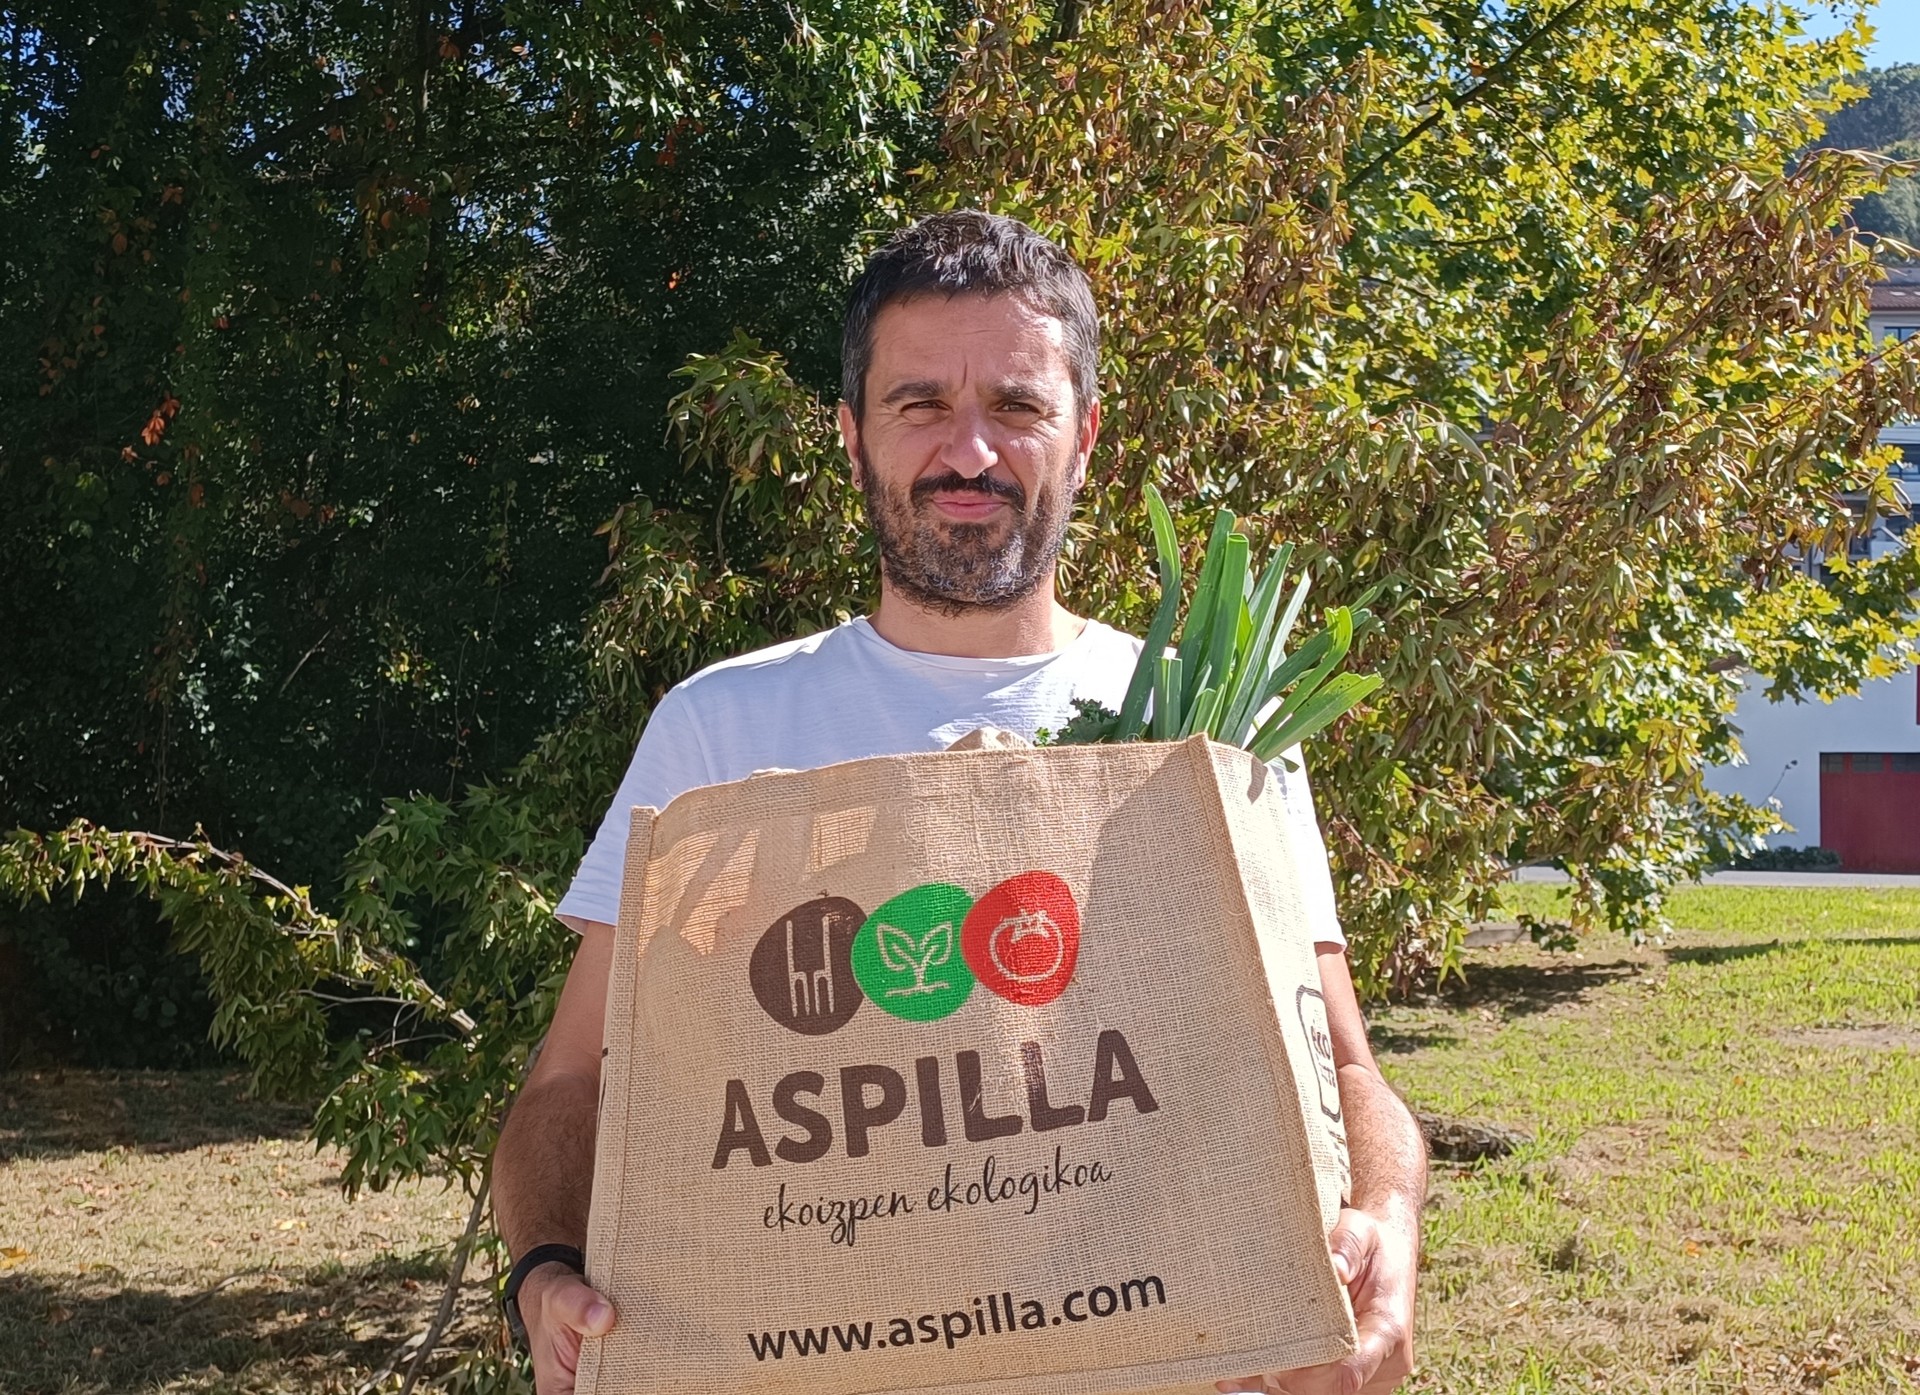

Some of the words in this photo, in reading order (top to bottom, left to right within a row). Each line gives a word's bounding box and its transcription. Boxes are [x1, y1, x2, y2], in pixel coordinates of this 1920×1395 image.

[711, 1029, 1159, 1170] ASPILLA
[763, 1183, 917, 1247] ekoizpen
[927, 1145, 1114, 1215] ekologikoa
[747, 1274, 1167, 1362] www.aspilla.com
